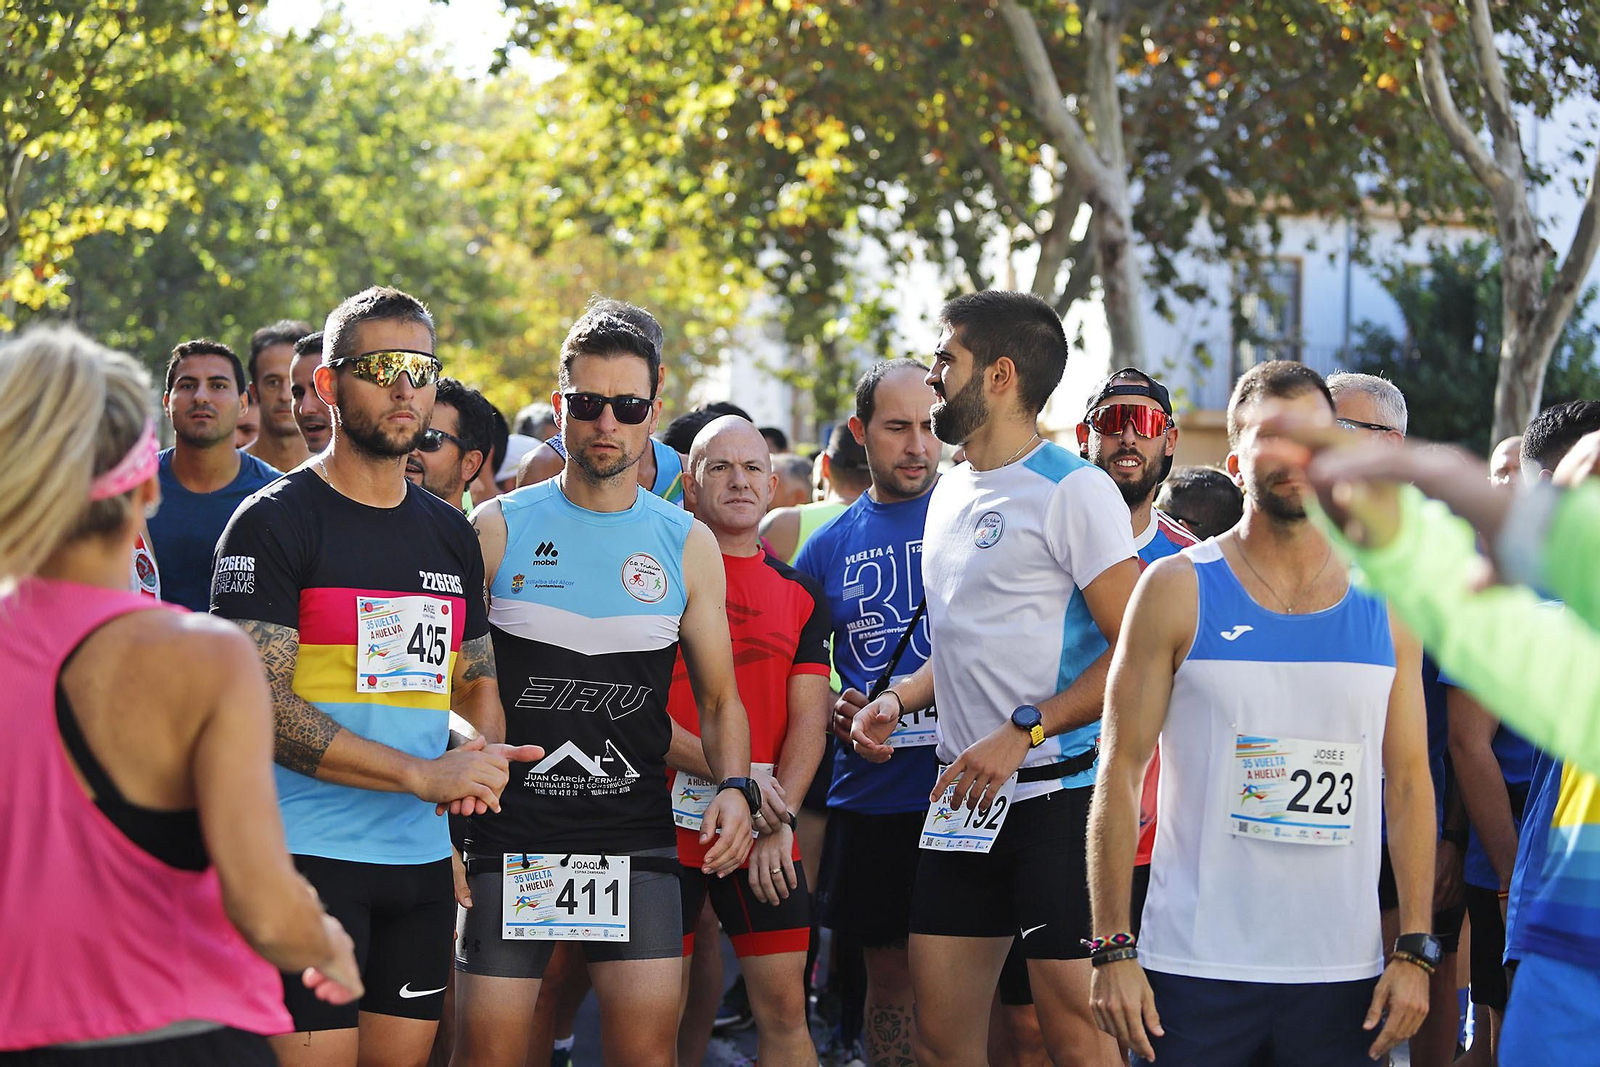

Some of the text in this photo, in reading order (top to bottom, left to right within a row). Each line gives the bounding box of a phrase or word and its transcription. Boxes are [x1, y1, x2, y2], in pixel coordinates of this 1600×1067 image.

[845, 545, 894, 566] VUELTA A
[219, 556, 255, 573] 226ERS
[233, 571, 255, 582] YOUR
[419, 570, 464, 594] 226ERS
[215, 580, 255, 595] DREAMS
[366, 614, 401, 630] 35 VUELTA
[370, 631, 376, 640] A
[376, 624, 404, 639] HUELVA
[407, 622, 447, 666] 425
[1242, 756, 1286, 769] 35 VUELTA
[1340, 751, 1345, 760] E
[525, 773, 550, 782] JUAN
[551, 774, 587, 784] GARCÍA
[1247, 768, 1287, 780] A HUELVA
[523, 781, 571, 789] MATERIALES
[687, 778, 718, 787] A HUEL
[1286, 769, 1354, 816] 223
[963, 795, 1008, 830] 192
[513, 869, 553, 884] 35 VUELTA
[519, 884, 525, 893] A
[526, 879, 554, 892] HUELVA
[555, 878, 619, 917] 411
